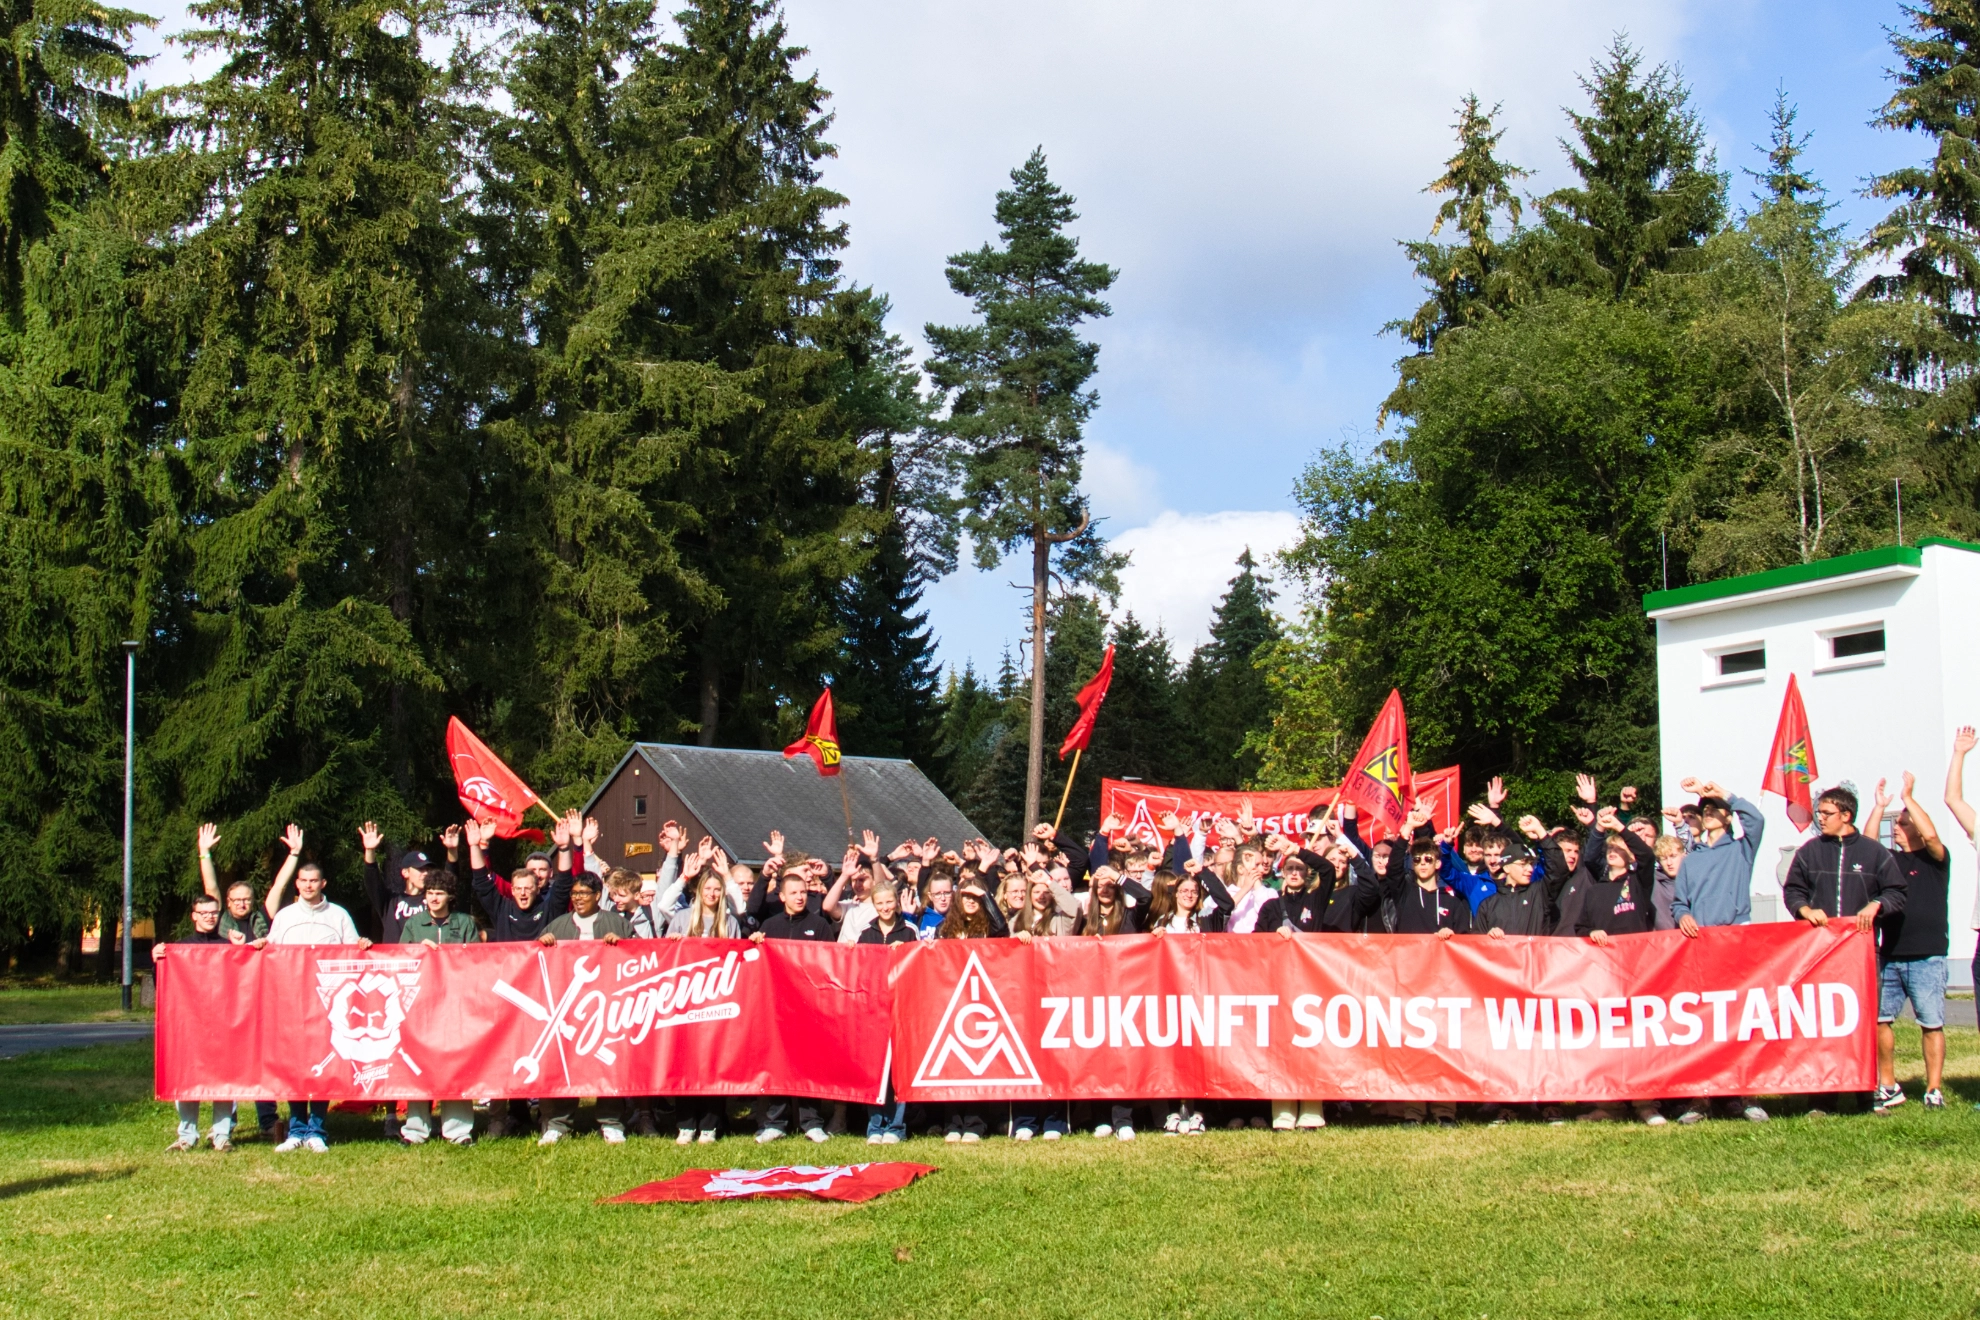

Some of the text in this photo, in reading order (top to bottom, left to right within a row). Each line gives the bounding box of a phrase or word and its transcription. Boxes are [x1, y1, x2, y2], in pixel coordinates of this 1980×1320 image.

[616, 951, 659, 981] IGM
[574, 950, 741, 1056] Jugend
[687, 1007, 733, 1021] CHEMNITZ
[1040, 982, 1860, 1050] ZUKUNFT SONST WIDERSTAND
